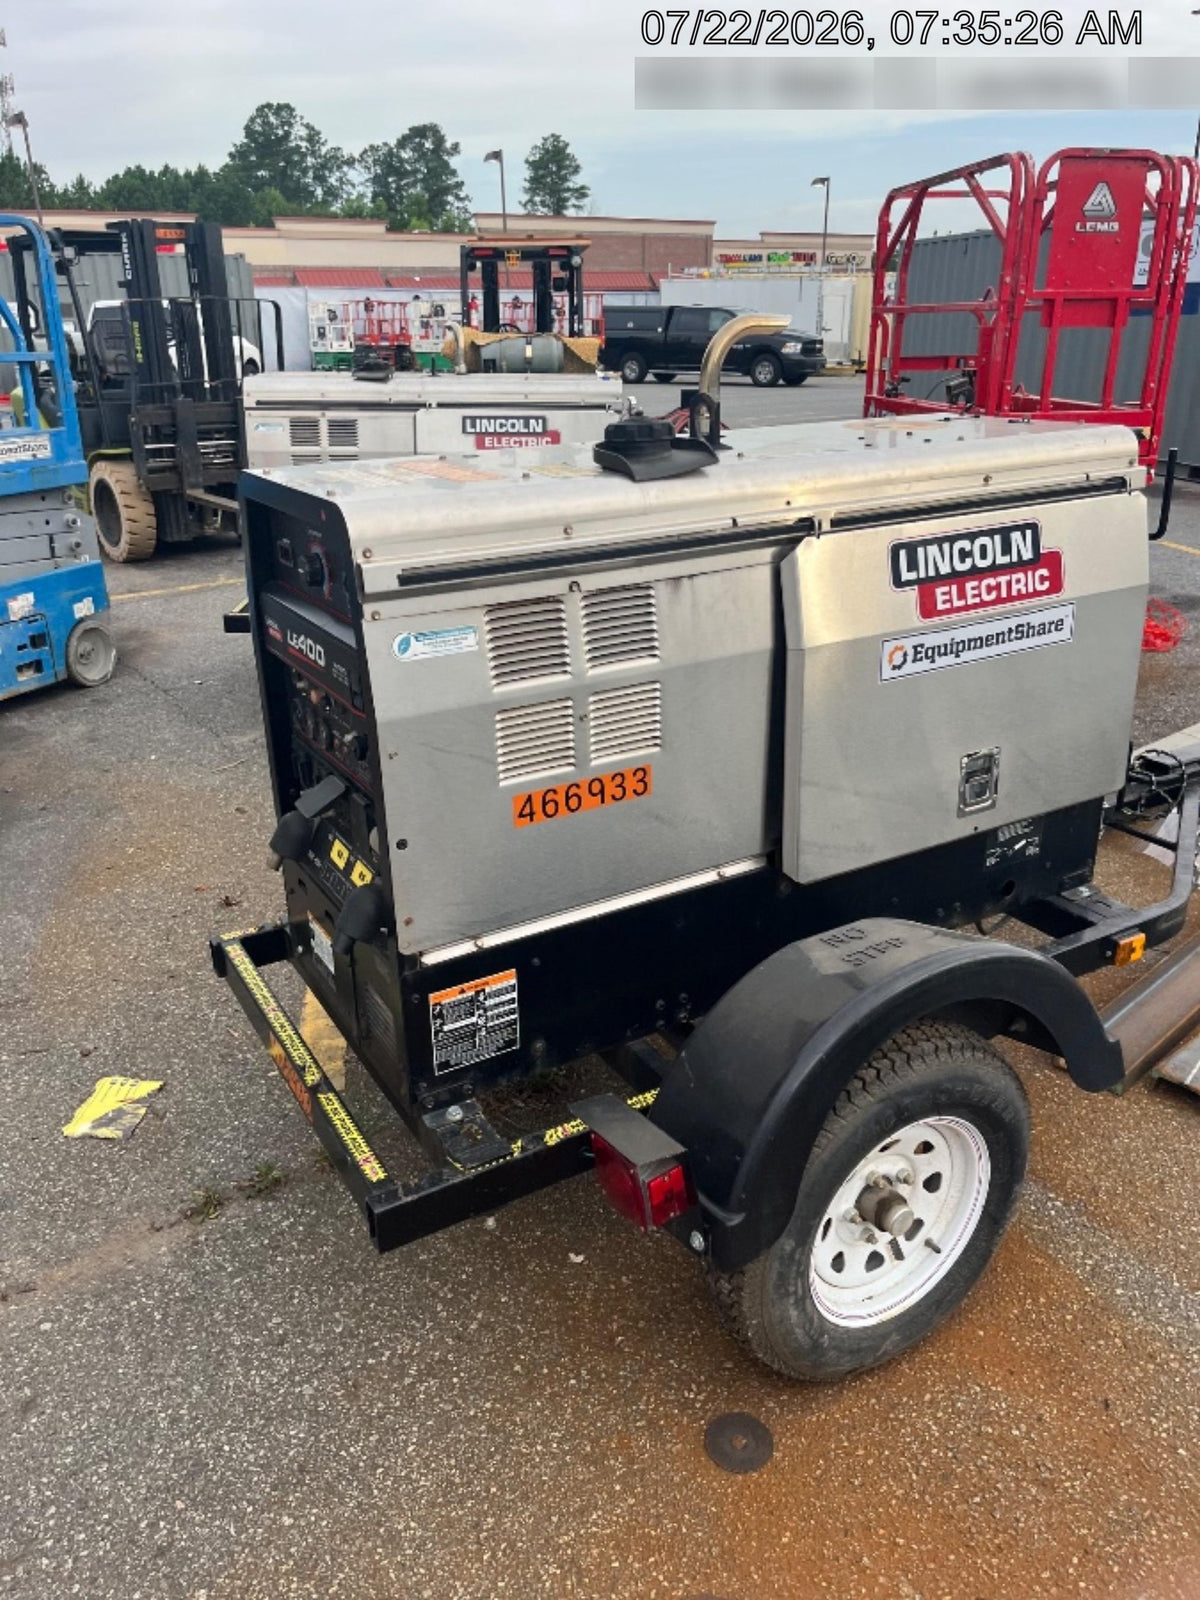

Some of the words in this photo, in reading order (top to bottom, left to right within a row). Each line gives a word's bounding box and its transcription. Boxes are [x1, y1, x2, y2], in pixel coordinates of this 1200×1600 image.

[466, 419, 543, 433] LINCOLN
[484, 437, 552, 448] ELECTRIC
[899, 529, 1033, 582] LINCOLN
[935, 568, 1050, 610] ELECTRIC
[911, 618, 1064, 663] EquipmentShare
[518, 767, 648, 822] 466933
[819, 928, 867, 948] NO
[841, 938, 903, 966] STEP
